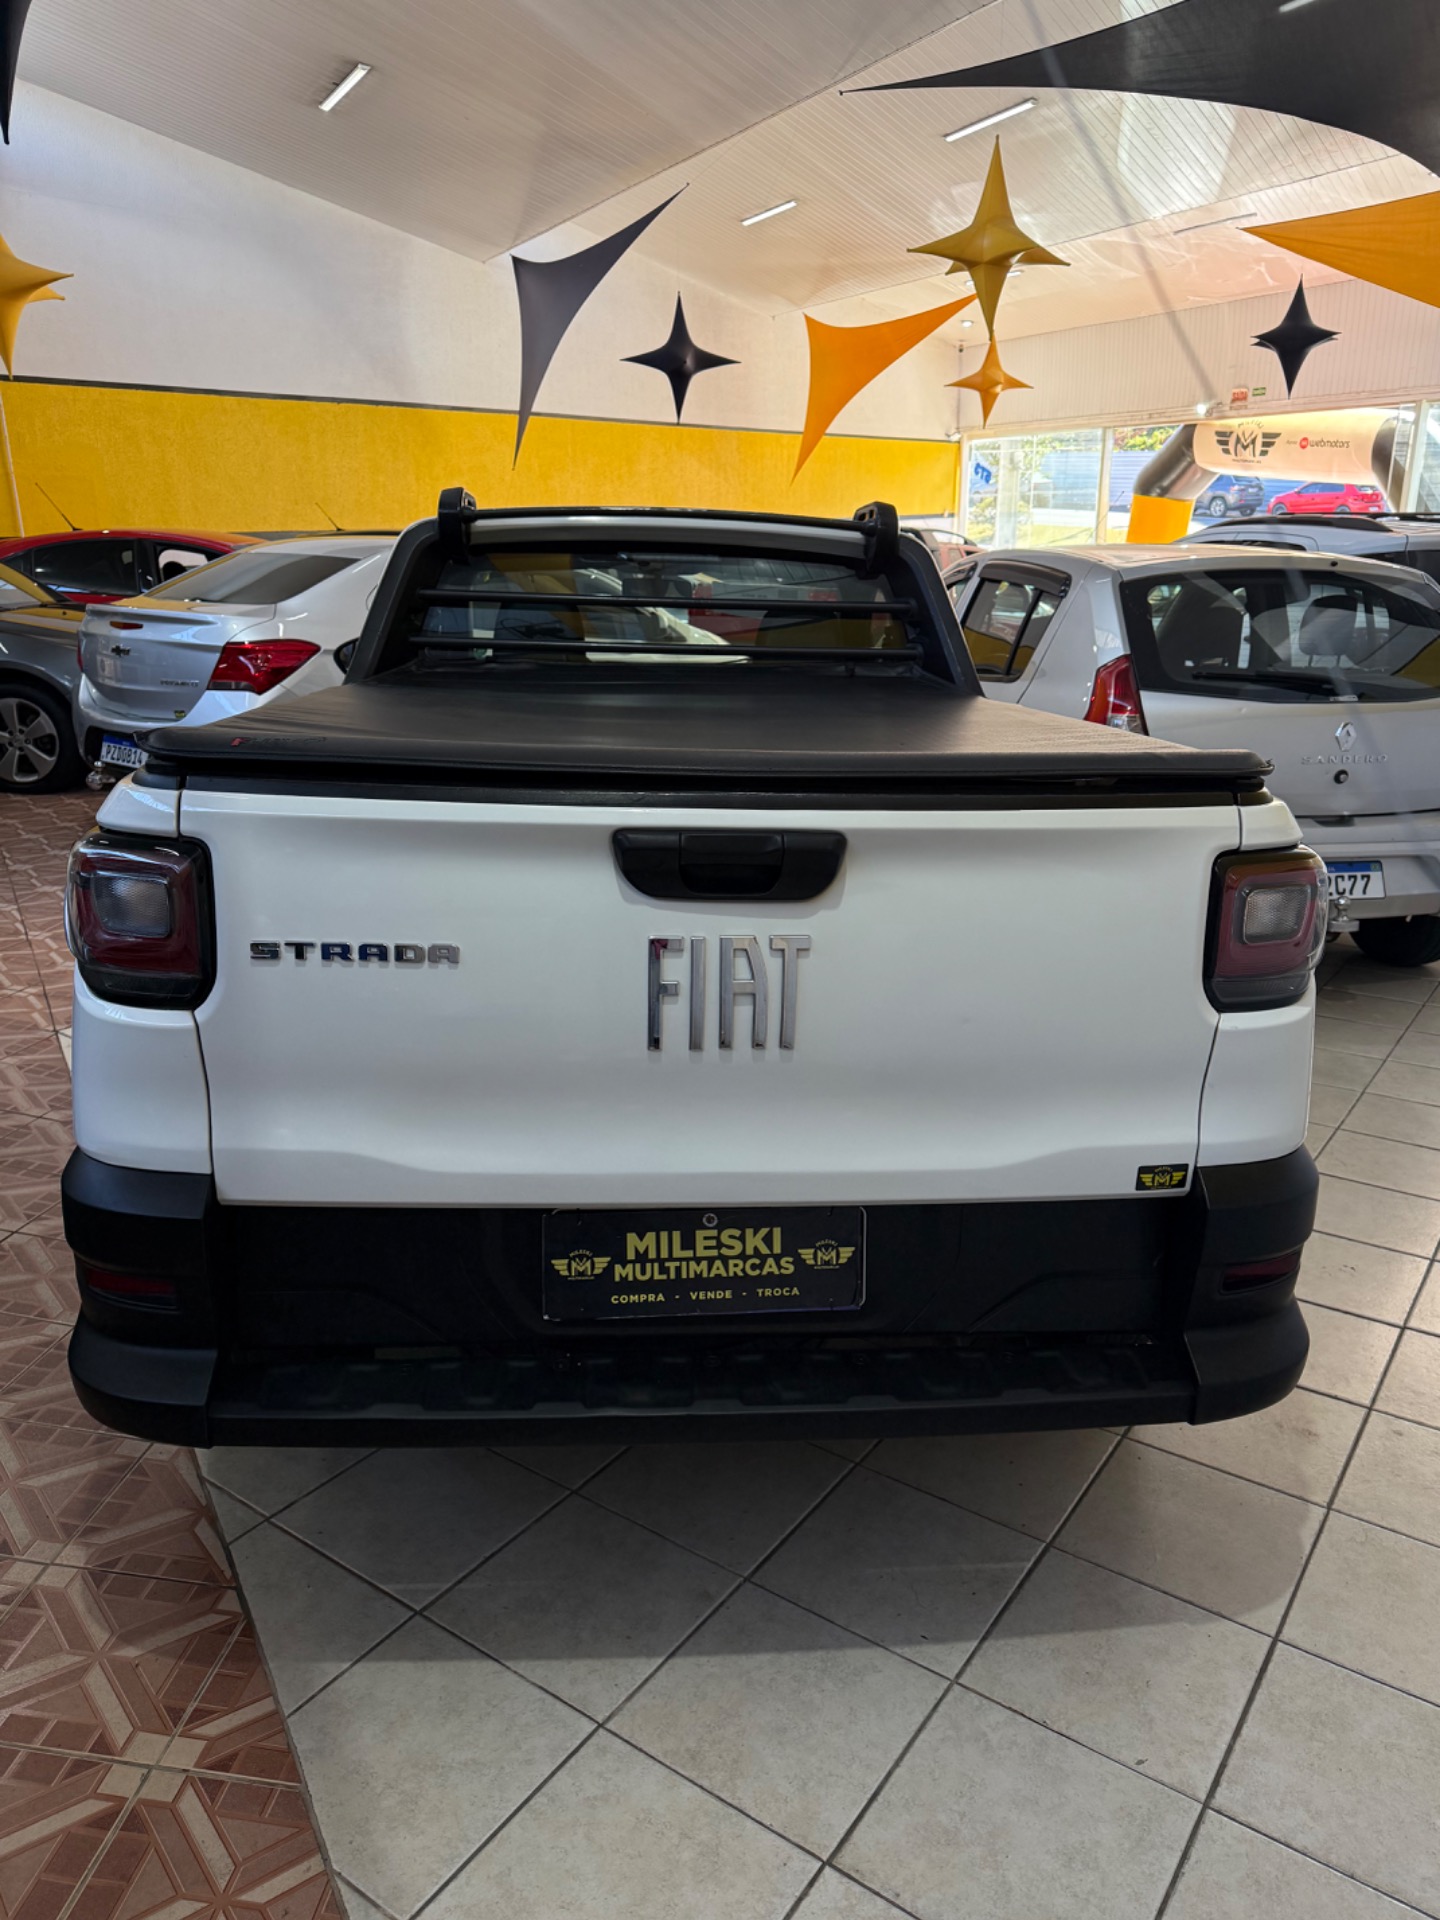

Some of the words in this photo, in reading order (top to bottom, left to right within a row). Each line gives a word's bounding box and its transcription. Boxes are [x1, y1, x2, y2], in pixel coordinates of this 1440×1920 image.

[1309, 437, 1350, 448] webmotors
[1300, 754, 1388, 765] SANDERO
[250, 940, 460, 964] STRADA
[648, 934, 812, 1051] FIAT
[626, 1227, 782, 1260] MILESKI
[613, 1257, 796, 1282] MULTIMARCAS
[611, 1293, 665, 1304] COMPRA
[690, 1290, 733, 1300] VENDE
[757, 1287, 800, 1297] TROCA
